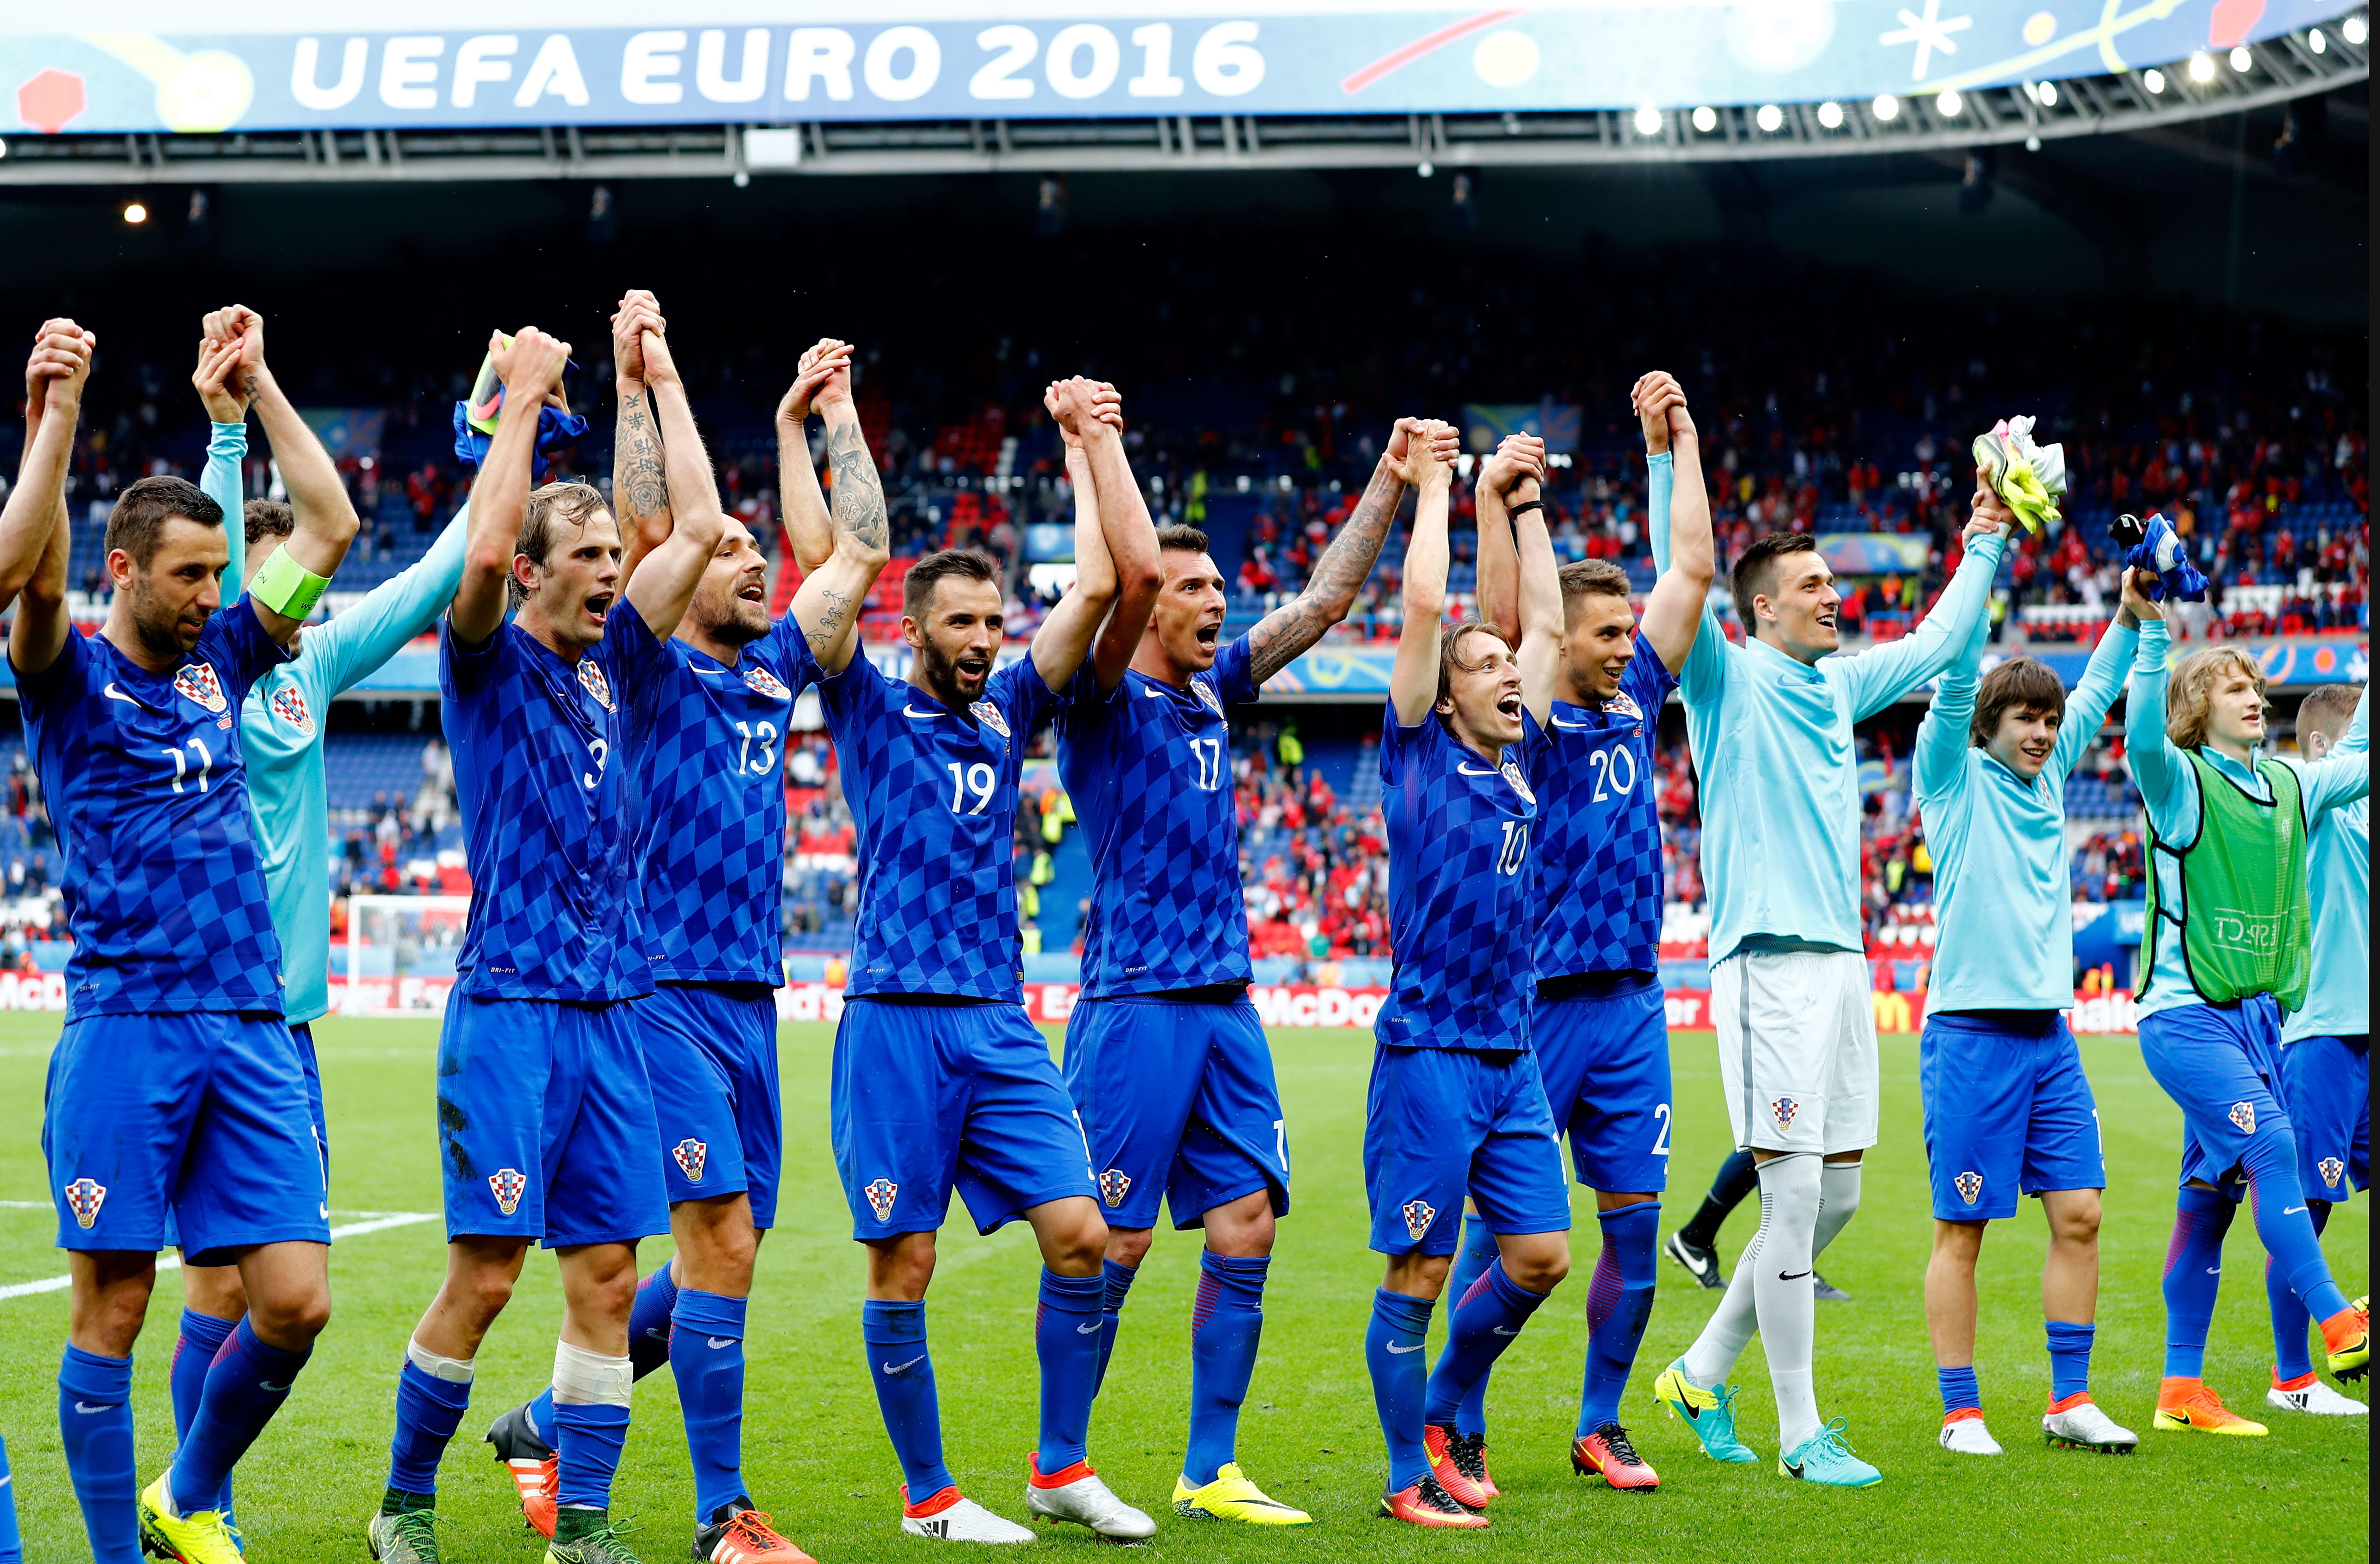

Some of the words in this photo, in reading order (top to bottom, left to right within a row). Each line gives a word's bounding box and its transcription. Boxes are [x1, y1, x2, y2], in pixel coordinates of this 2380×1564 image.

[289, 33, 590, 110] UEFA
[619, 25, 942, 105] EURO
[969, 21, 1266, 100] 2016
[161, 738, 212, 792] 11
[584, 738, 608, 789] 3
[736, 720, 777, 775] 13
[1189, 738, 1220, 790] 17
[1590, 744, 1635, 803] 20
[947, 762, 995, 815] 19
[1497, 821, 1527, 876] 10
